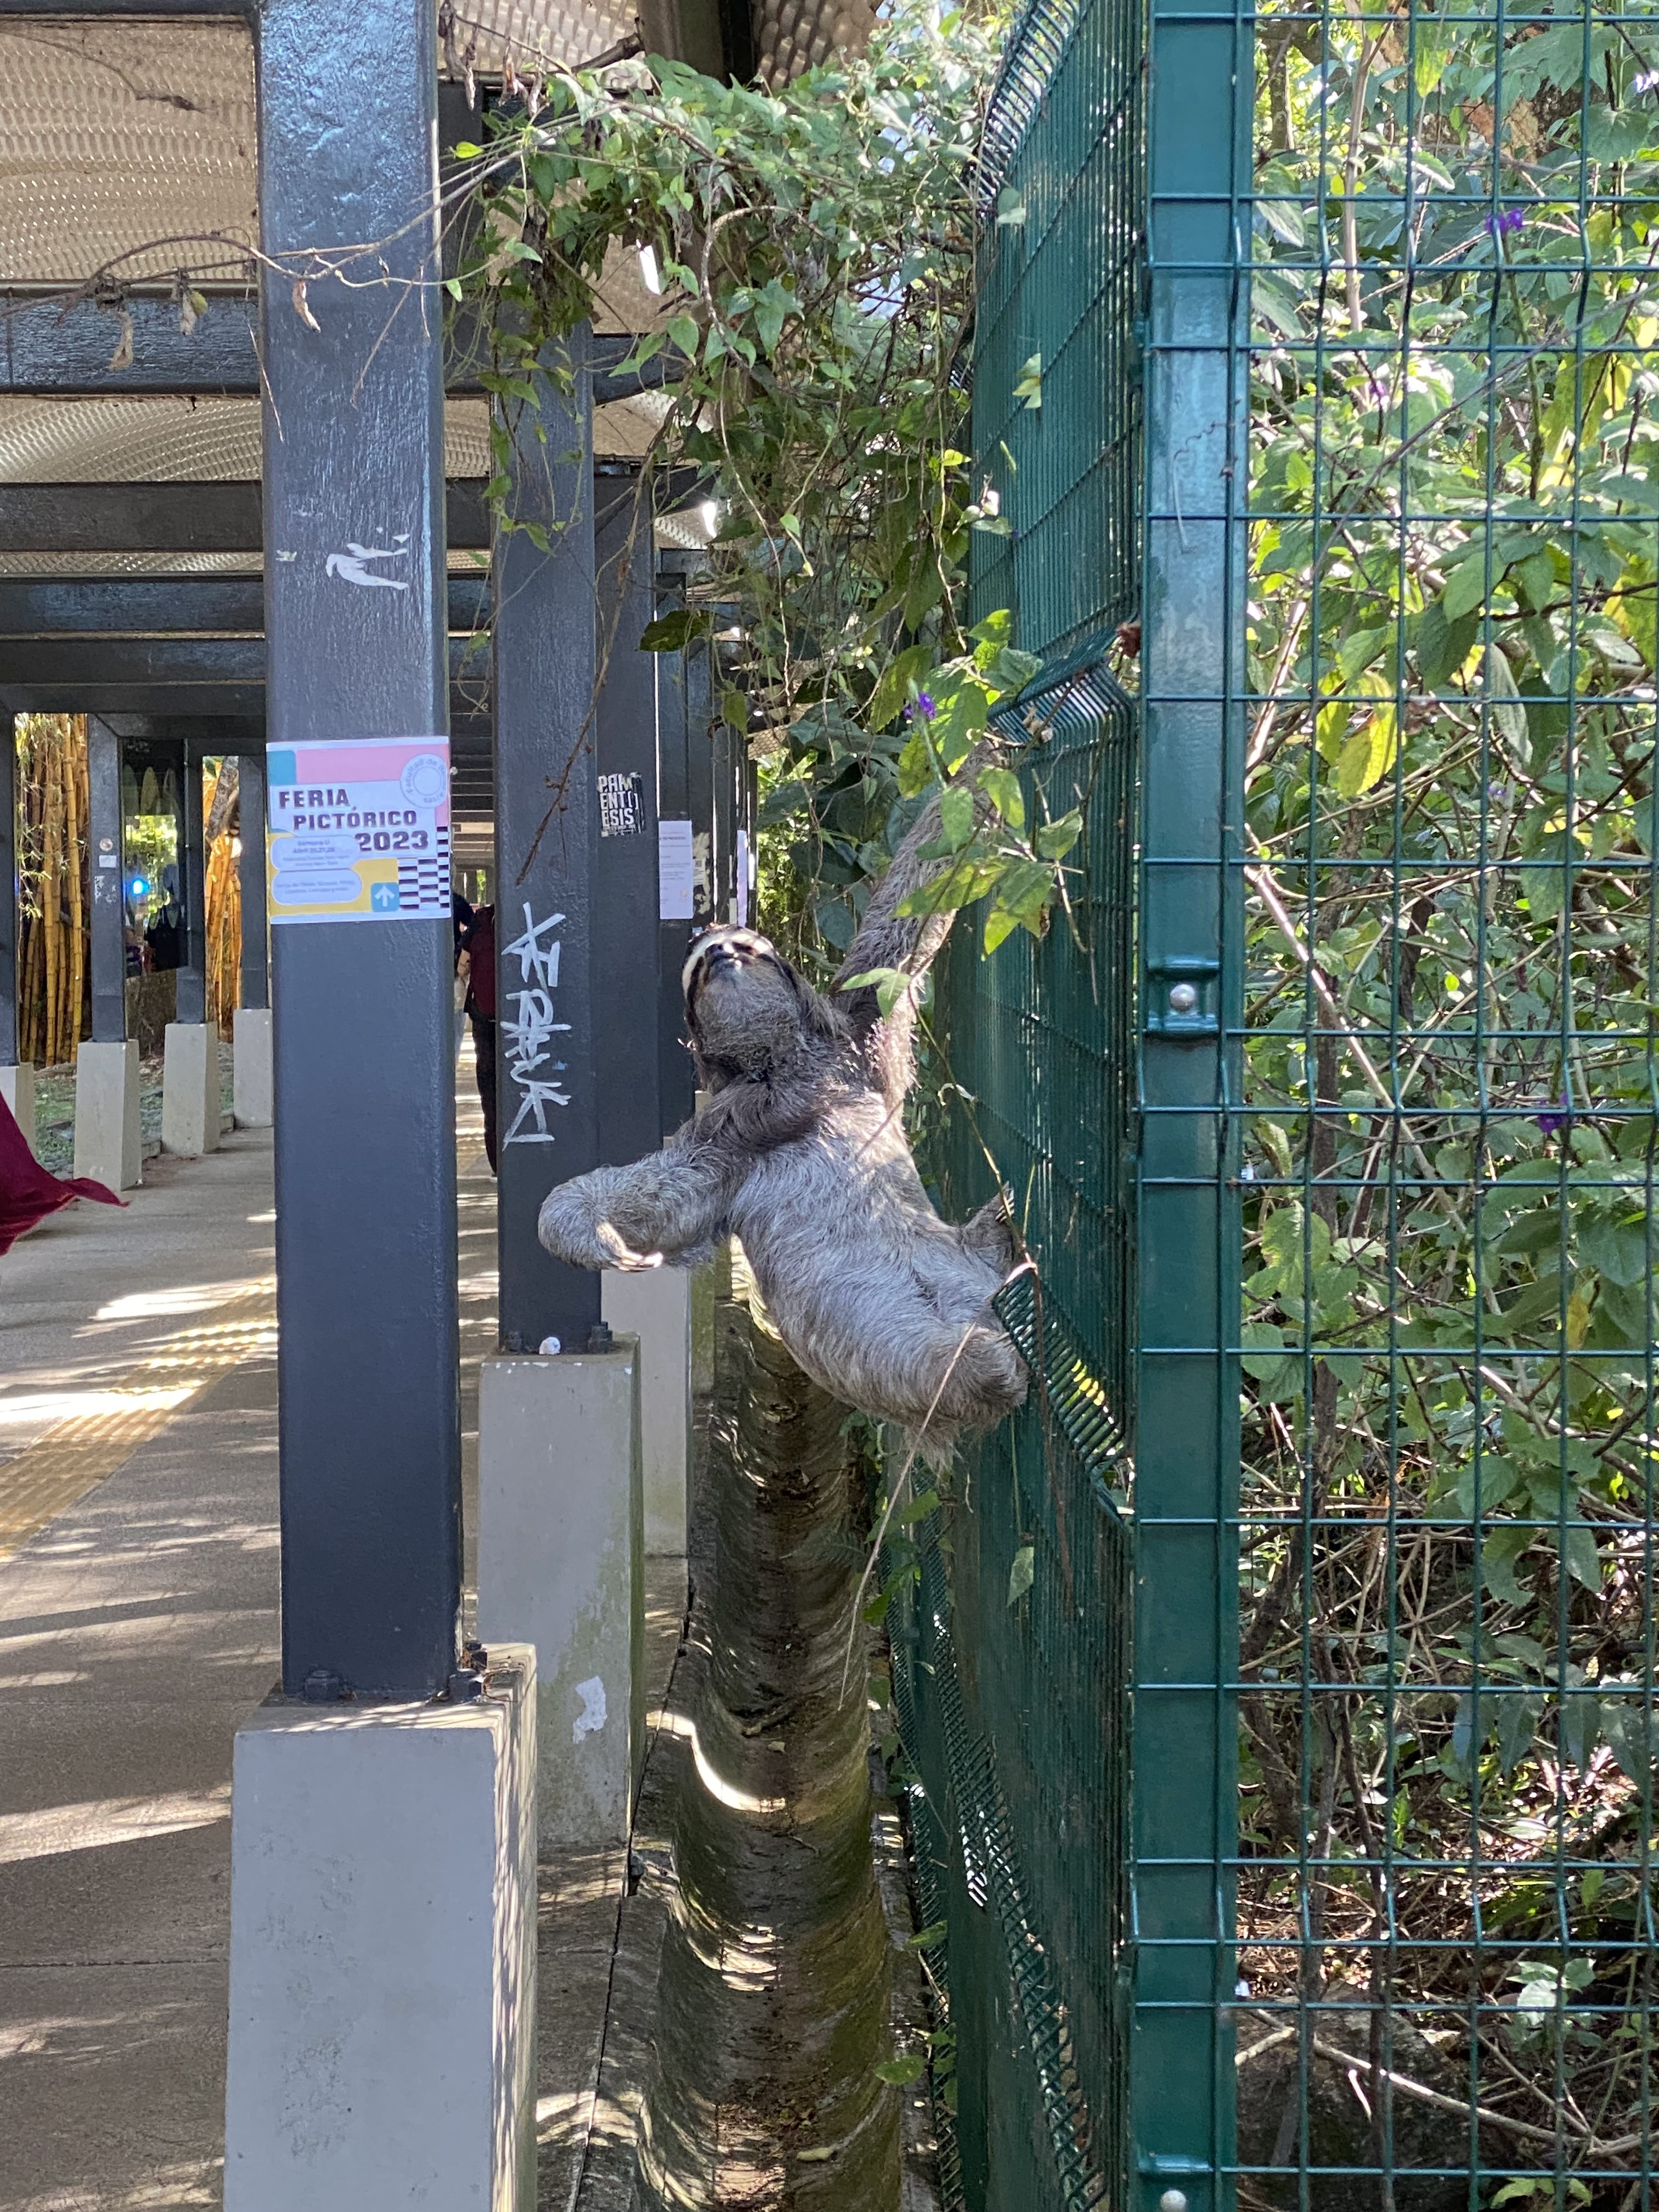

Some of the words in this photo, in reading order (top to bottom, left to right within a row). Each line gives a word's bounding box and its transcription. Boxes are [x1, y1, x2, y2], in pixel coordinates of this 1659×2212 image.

[279, 789, 349, 809] FERIA
[294, 806, 417, 831] PICTÓRICO
[601, 808, 634, 827] ESIS
[355, 831, 428, 851] 2023
